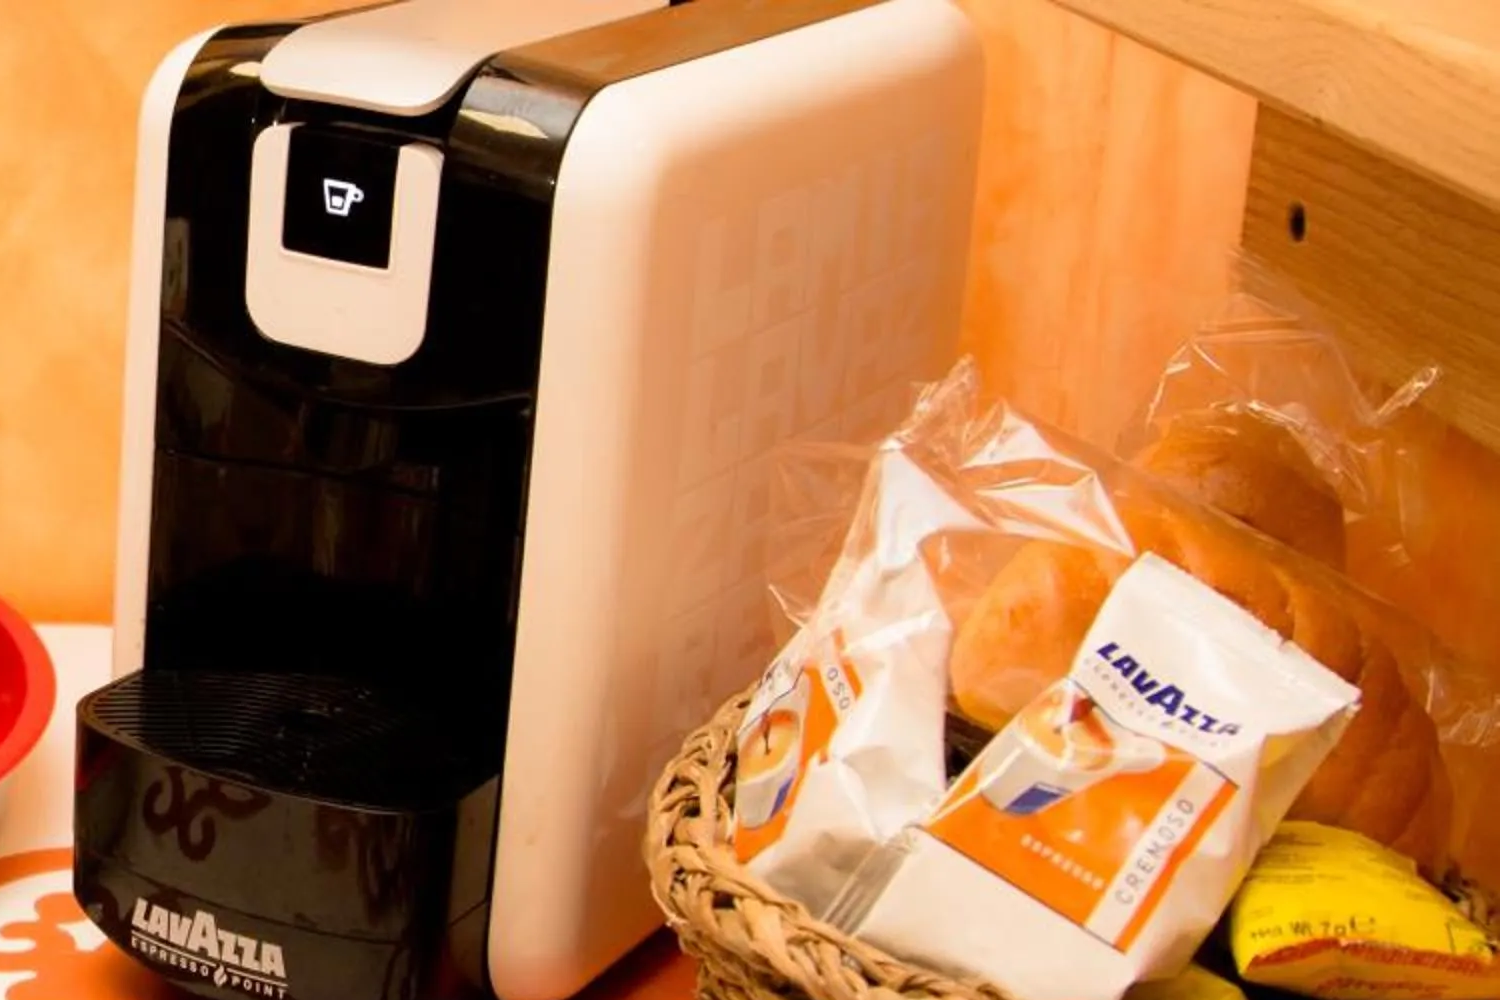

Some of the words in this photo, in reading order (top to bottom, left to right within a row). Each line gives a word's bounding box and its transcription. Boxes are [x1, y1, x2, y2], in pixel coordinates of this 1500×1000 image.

[1095, 641, 1243, 736] LAVAZZA
[1114, 797, 1195, 906] CREMOSO
[131, 897, 287, 978] LAVAZZA
[131, 937, 210, 977] ESPRESSO
[231, 976, 288, 1000] POINT
